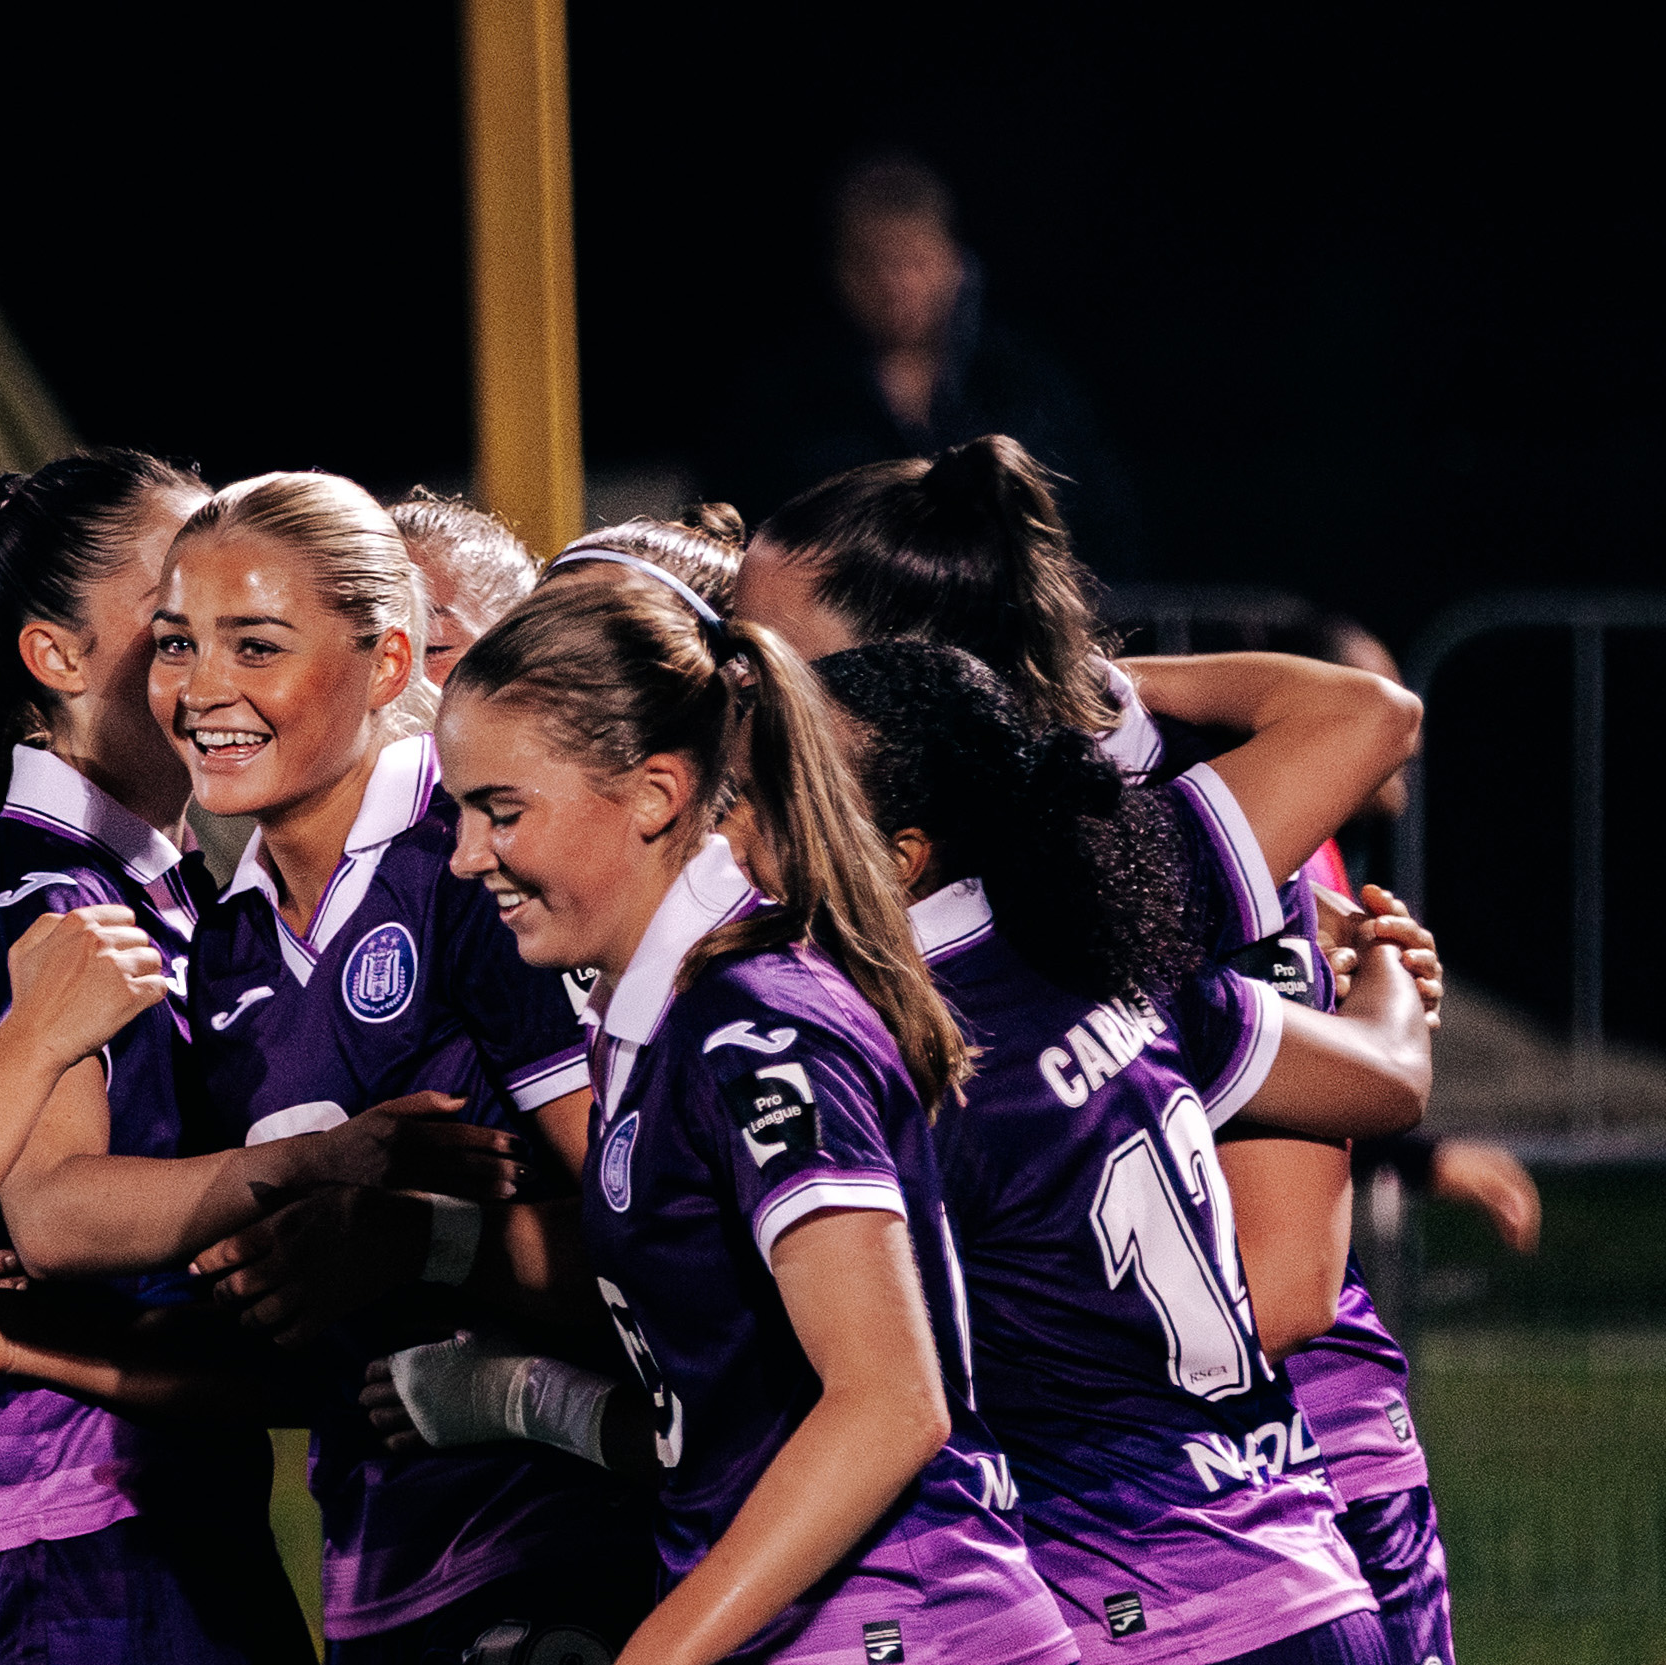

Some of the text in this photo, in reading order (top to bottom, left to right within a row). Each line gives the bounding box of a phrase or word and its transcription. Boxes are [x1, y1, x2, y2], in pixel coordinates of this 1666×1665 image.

[1273, 963, 1296, 977] Pro
[754, 1094, 783, 1112] Pro
[750, 1104, 802, 1134] League
[1088, 1086, 1275, 1402] 12
